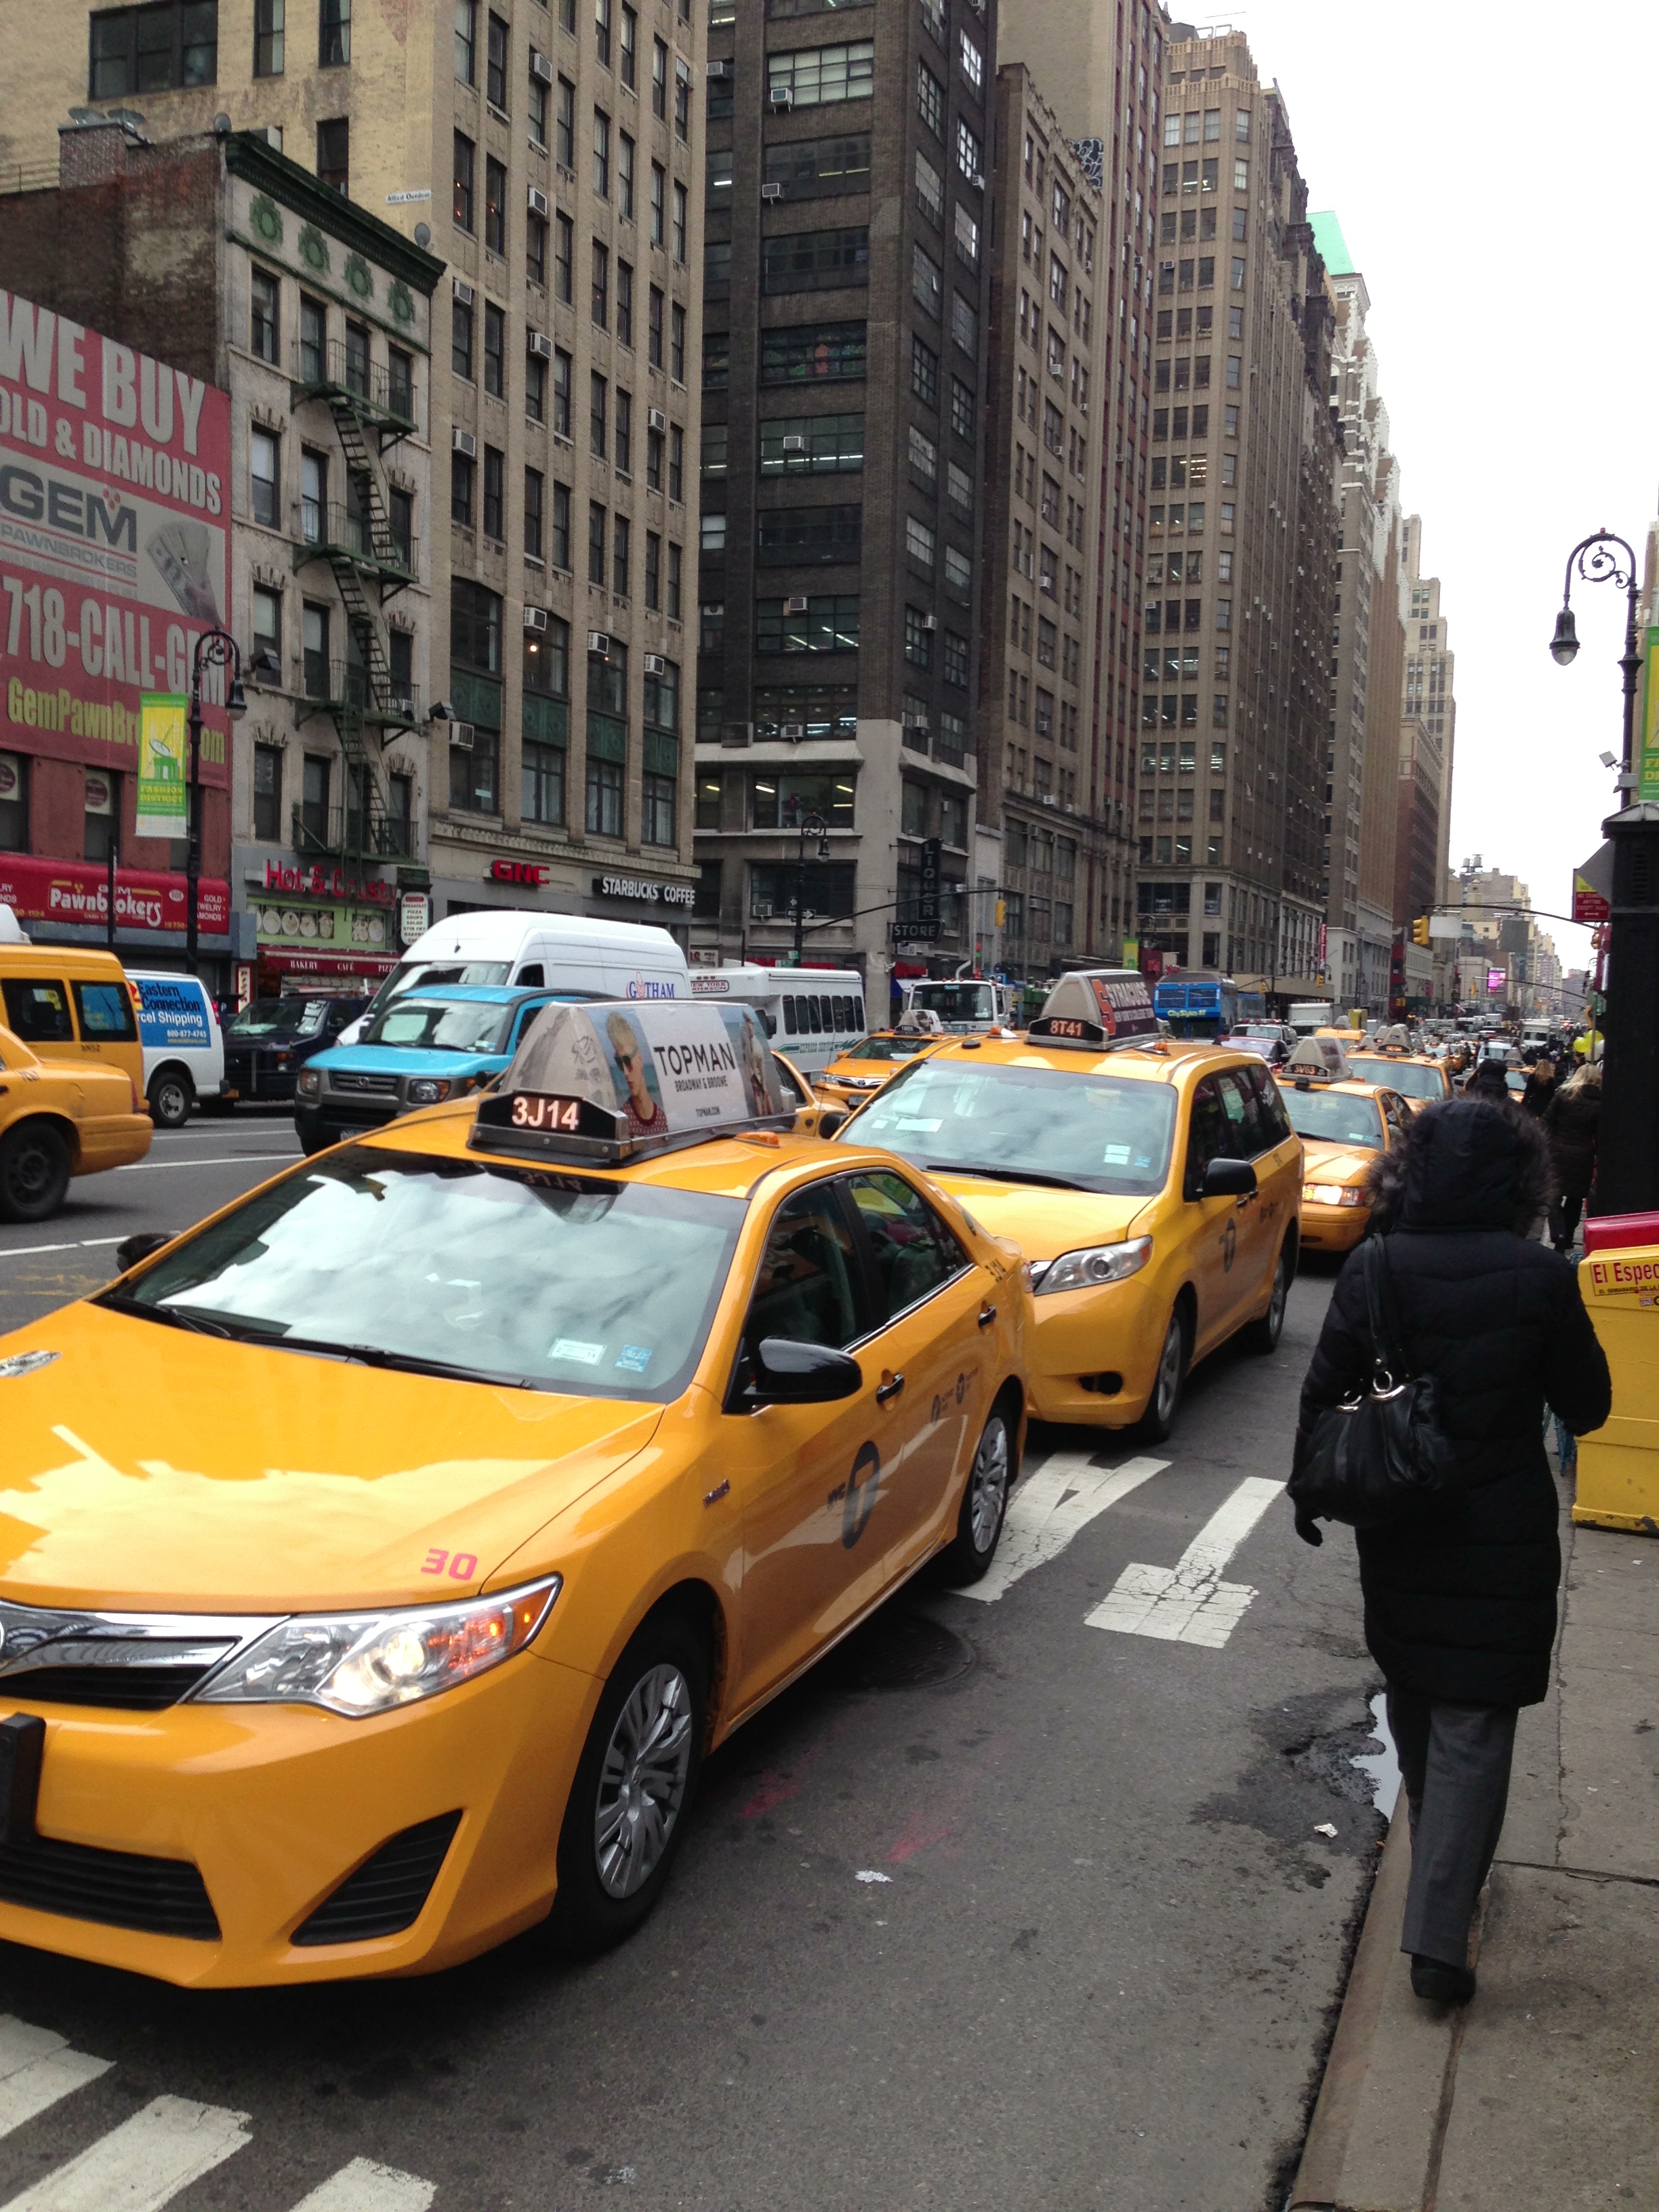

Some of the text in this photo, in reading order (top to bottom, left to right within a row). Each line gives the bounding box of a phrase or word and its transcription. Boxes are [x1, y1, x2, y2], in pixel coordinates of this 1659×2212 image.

[0, 288, 206, 457] WE BUY
[56, 417, 77, 461] &
[83, 421, 222, 516] DIAMONDS
[0, 464, 137, 553] GEM
[1, 523, 137, 577] PAWNBROKERS
[140, 794, 182, 802] DISTRICT
[265, 859, 305, 891] Hot
[311, 865, 325, 894] &
[492, 859, 550, 885] GNC
[923, 844, 935, 916] LIQUOR
[98, 884, 130, 895] GM
[204, 895, 222, 903] GOLD
[602, 877, 695, 905] STARBUCKS COFFEE
[50, 888, 161, 927] Pawnbokers
[895, 925, 935, 937] STORE
[290, 960, 319, 970] BAKERY
[136, 981, 180, 996] Eastern
[141, 992, 201, 1011] Connection
[1105, 982, 1151, 1008] SYRACUSE
[137, 1010, 203, 1027] rcel Shipping
[1050, 1020, 1082, 1037] 8T41
[653, 1042, 736, 1076] TOPMAN
[512, 1096, 580, 1130] 3J14
[1593, 1264, 1608, 1284] El
[420, 1548, 478, 1581] 30
